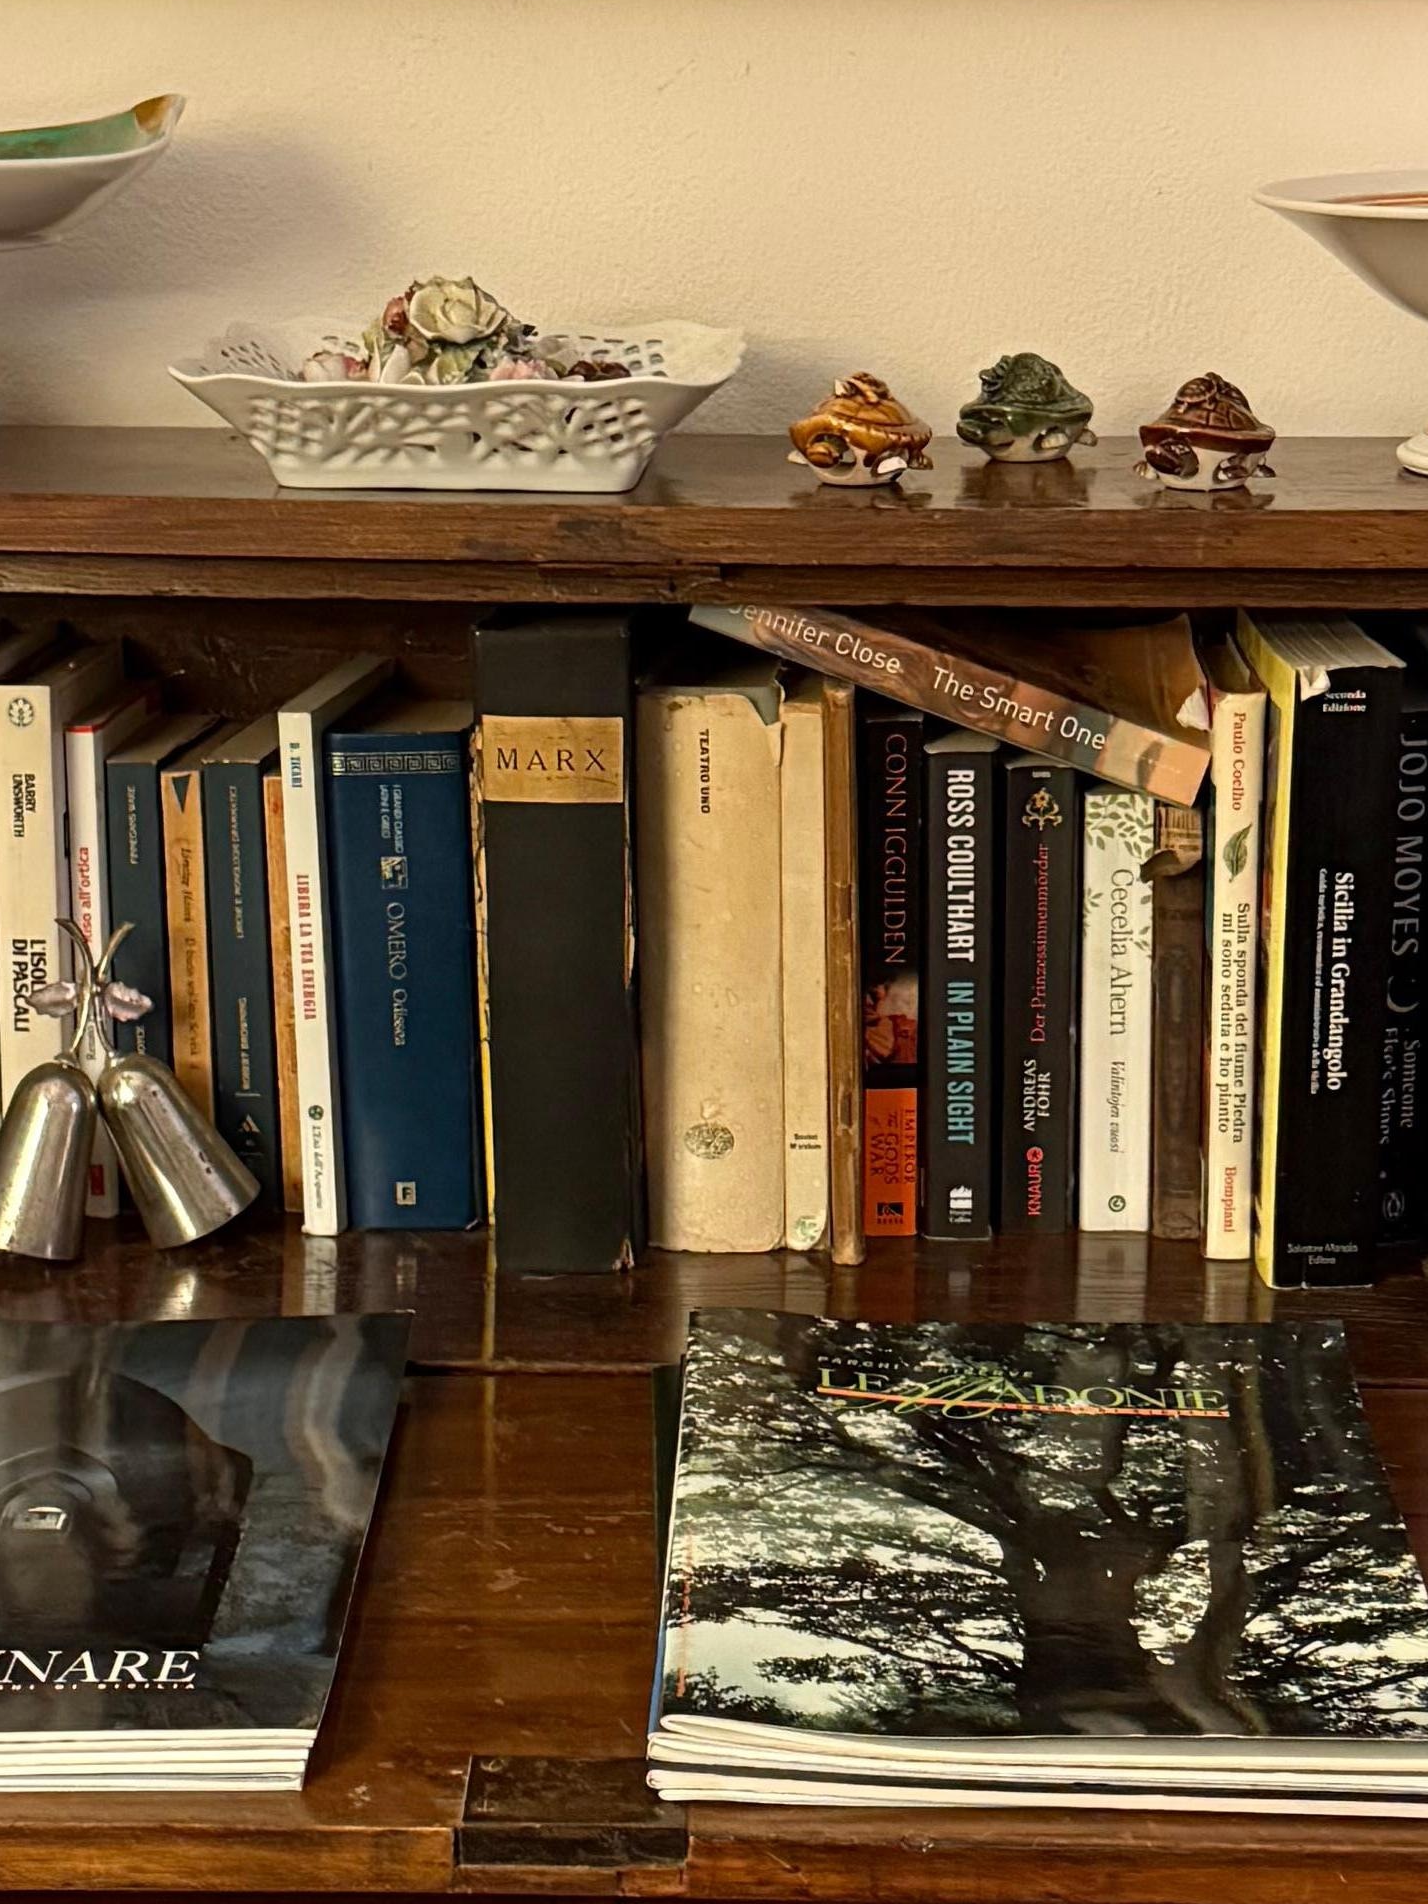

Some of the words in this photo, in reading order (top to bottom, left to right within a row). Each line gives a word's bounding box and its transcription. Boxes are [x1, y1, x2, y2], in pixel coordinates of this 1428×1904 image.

[835, 633, 902, 674] Close
[933, 666, 975, 701] The
[979, 686, 1054, 731] Smart
[1060, 716, 1106, 750] One
[1231, 711, 1248, 755] Paulo
[496, 745, 607, 773] MARX
[699, 728, 710, 783] TEATRO
[883, 733, 906, 817] CONN
[1397, 733, 1428, 822] JOJO
[12, 774, 25, 838] UNSWORTH
[24, 774, 36, 814] BARRY
[699, 786, 711, 814] UNO
[946, 769, 975, 827] ROSS
[1229, 759, 1247, 811] Coelho
[77, 847, 92, 907] all'ortica
[296, 874, 312, 918] LIBERA
[883, 826, 907, 964] IGGULDEN
[946, 835, 975, 963] COULTHART
[1332, 871, 1356, 932] Sicilia
[1390, 835, 1424, 957] MOYES
[299, 922, 313, 937] LA
[1109, 868, 1134, 958] Cecelia
[1221, 912, 1236, 933] mi
[1235, 903, 1251, 944] Sulla
[12, 938, 26, 957] DI
[28, 938, 46, 994] L'ISOL
[299, 942, 314, 964] TUA
[386, 901, 408, 981] OMERO
[1219, 938, 1232, 979] sono
[1331, 937, 1353, 958] in
[12, 961, 30, 1032] PASCALI
[301, 969, 317, 1020] ENERGIA
[947, 982, 974, 1003] IN
[1108, 965, 1132, 1036] Ahern
[1230, 949, 1249, 1009] sponda
[392, 988, 408, 1047] Odissea
[1029, 1012, 1048, 1042] Der
[1218, 983, 1235, 1039] seduta
[1233, 1013, 1249, 1038] del
[1323, 962, 1352, 1092] Grandangolo
[947, 1012, 974, 1074] PLAIN
[1217, 1057, 1233, 1079] ho
[1218, 1043, 1229, 1053] e
[1232, 1042, 1248, 1089] fiume
[1021, 1058, 1037, 1133] ANDREAS
[1107, 1060, 1126, 1117] Valintojen
[1214, 1082, 1234, 1134] pianto
[1398, 1039, 1420, 1129] Someone
[947, 1081, 975, 1145] SIGHT
[1108, 1121, 1124, 1153] vuosi
[1231, 1093, 1248, 1144] Piedra
[869, 1133, 885, 1176] WAR
[883, 1133, 899, 1184] GODS
[1025, 1163, 1044, 1217] KNAUR
[1220, 1165, 1238, 1234] Bompiani
[818, 1368, 890, 1392] LE
[867, 1374, 1230, 1419] MADONIE
